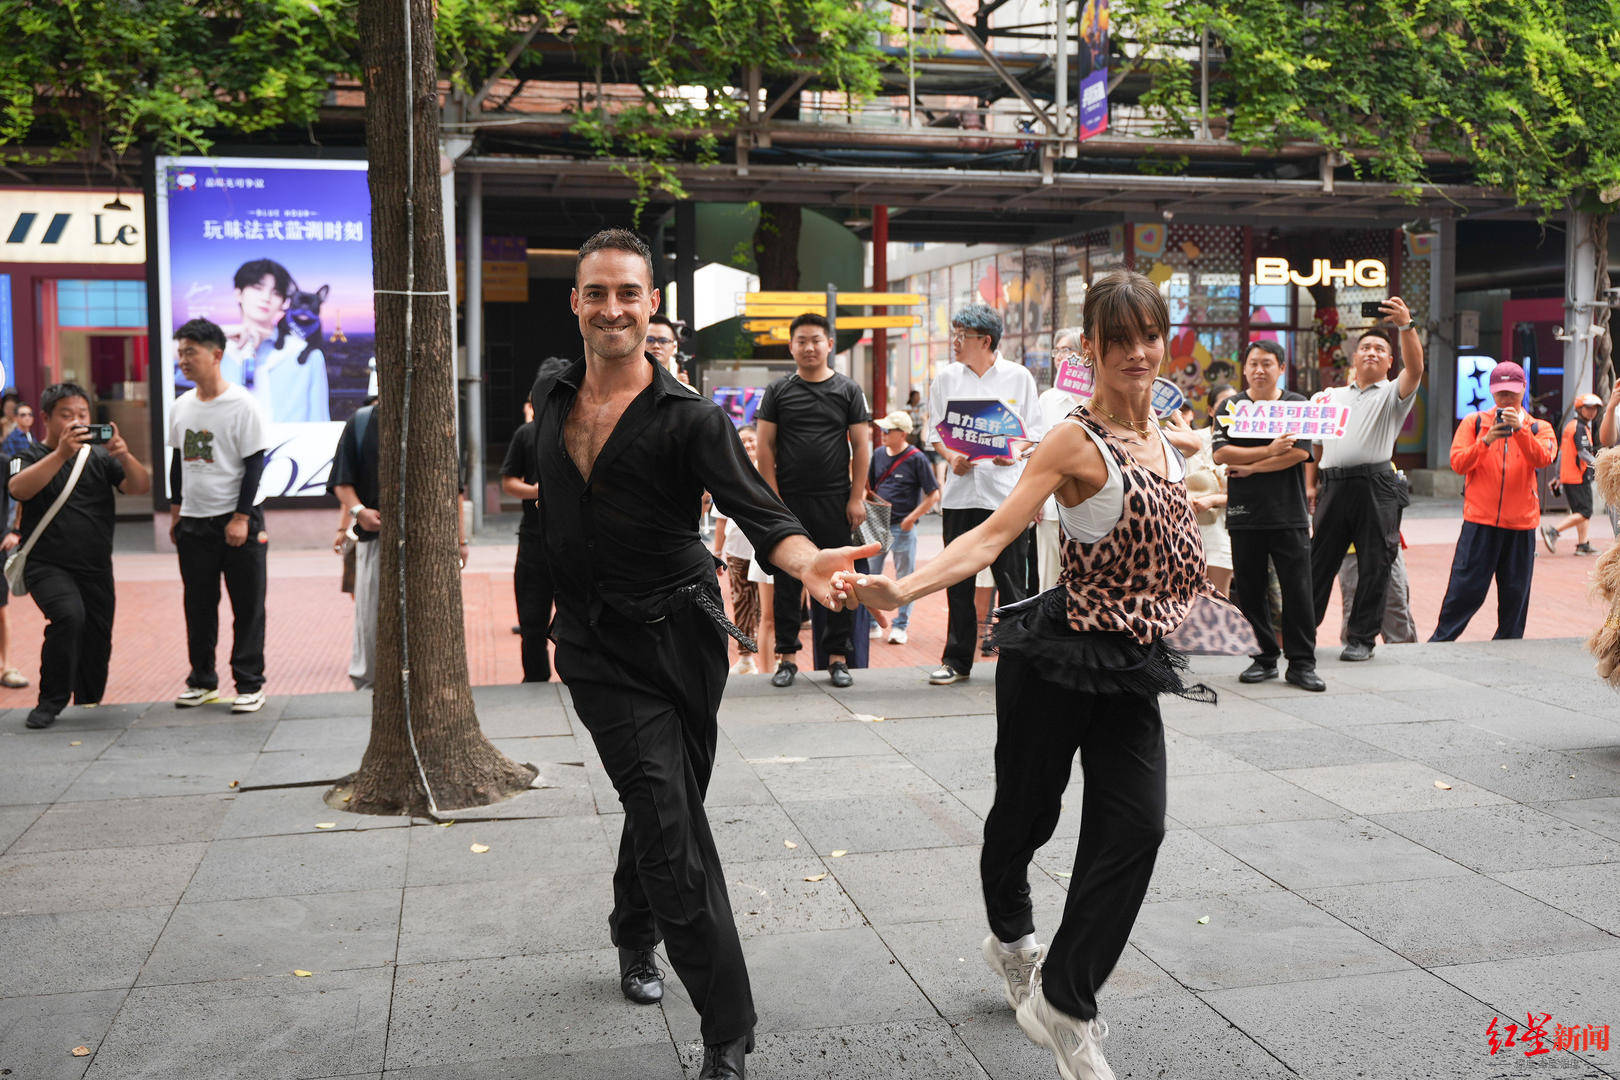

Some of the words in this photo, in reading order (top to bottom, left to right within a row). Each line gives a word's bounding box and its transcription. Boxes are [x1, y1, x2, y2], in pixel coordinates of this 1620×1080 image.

[93, 213, 138, 246] Le
[203, 219, 363, 242] 玩味法式蓝调时刻
[1256, 257, 1387, 288] BJHG
[1236, 405, 1336, 419] 人人皆可起舞
